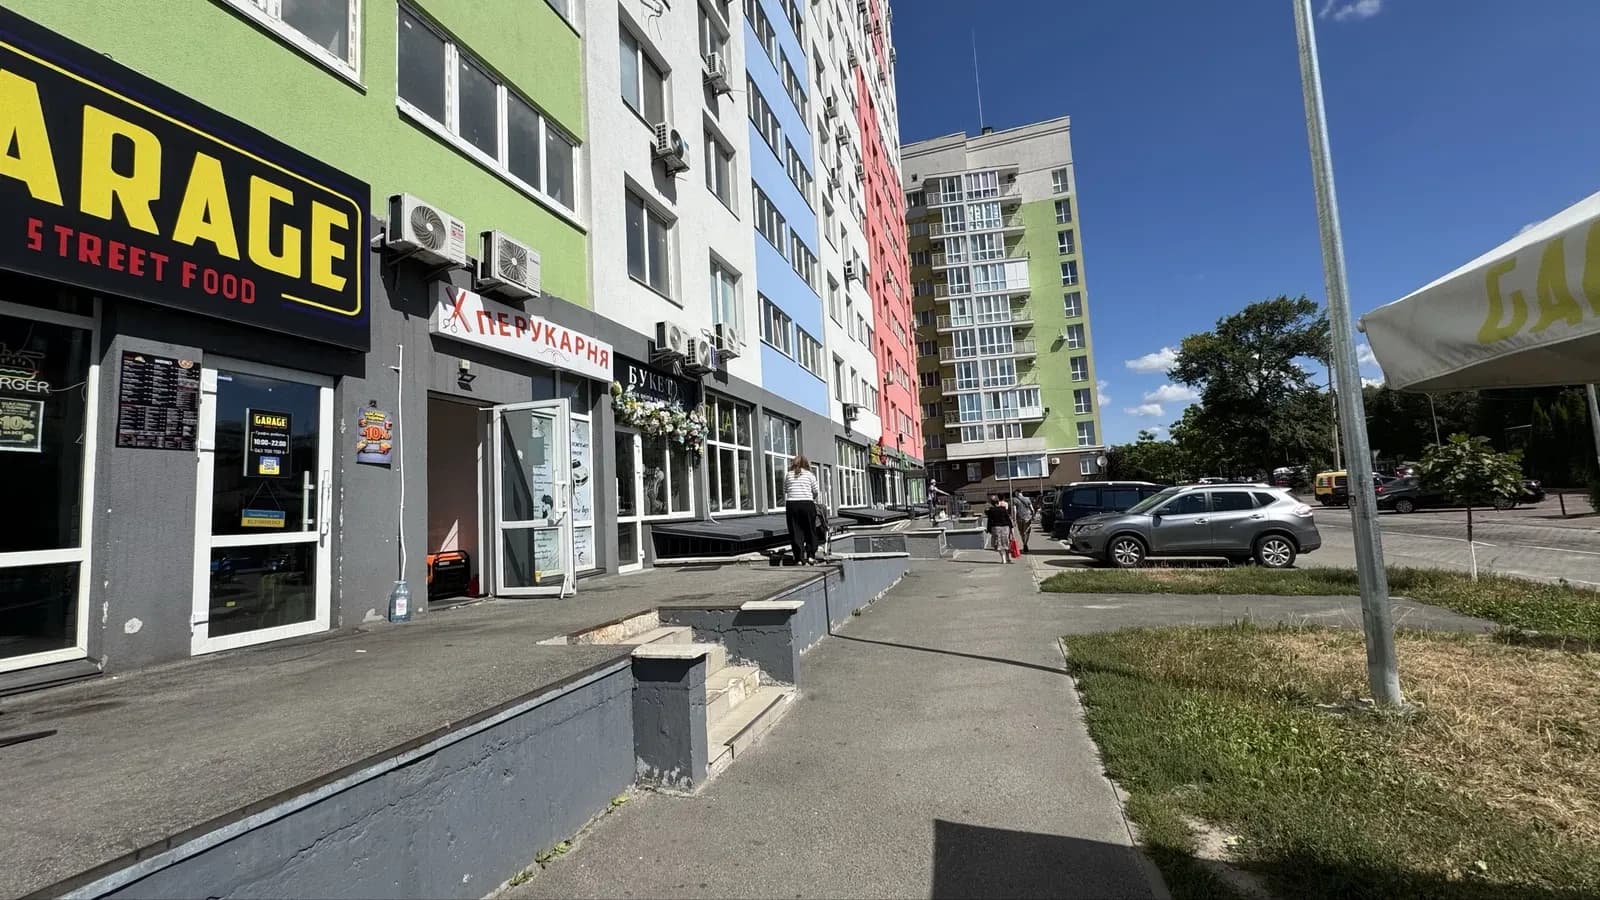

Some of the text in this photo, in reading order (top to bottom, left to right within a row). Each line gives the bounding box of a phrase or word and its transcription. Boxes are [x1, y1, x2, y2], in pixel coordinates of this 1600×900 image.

[27, 217, 256, 304] STREET FOOD
[476, 310, 609, 369] ПЕРУКАРНЯ
[628, 365, 676, 397] БУКЕТ
[255, 416, 286, 427] GARAGE
